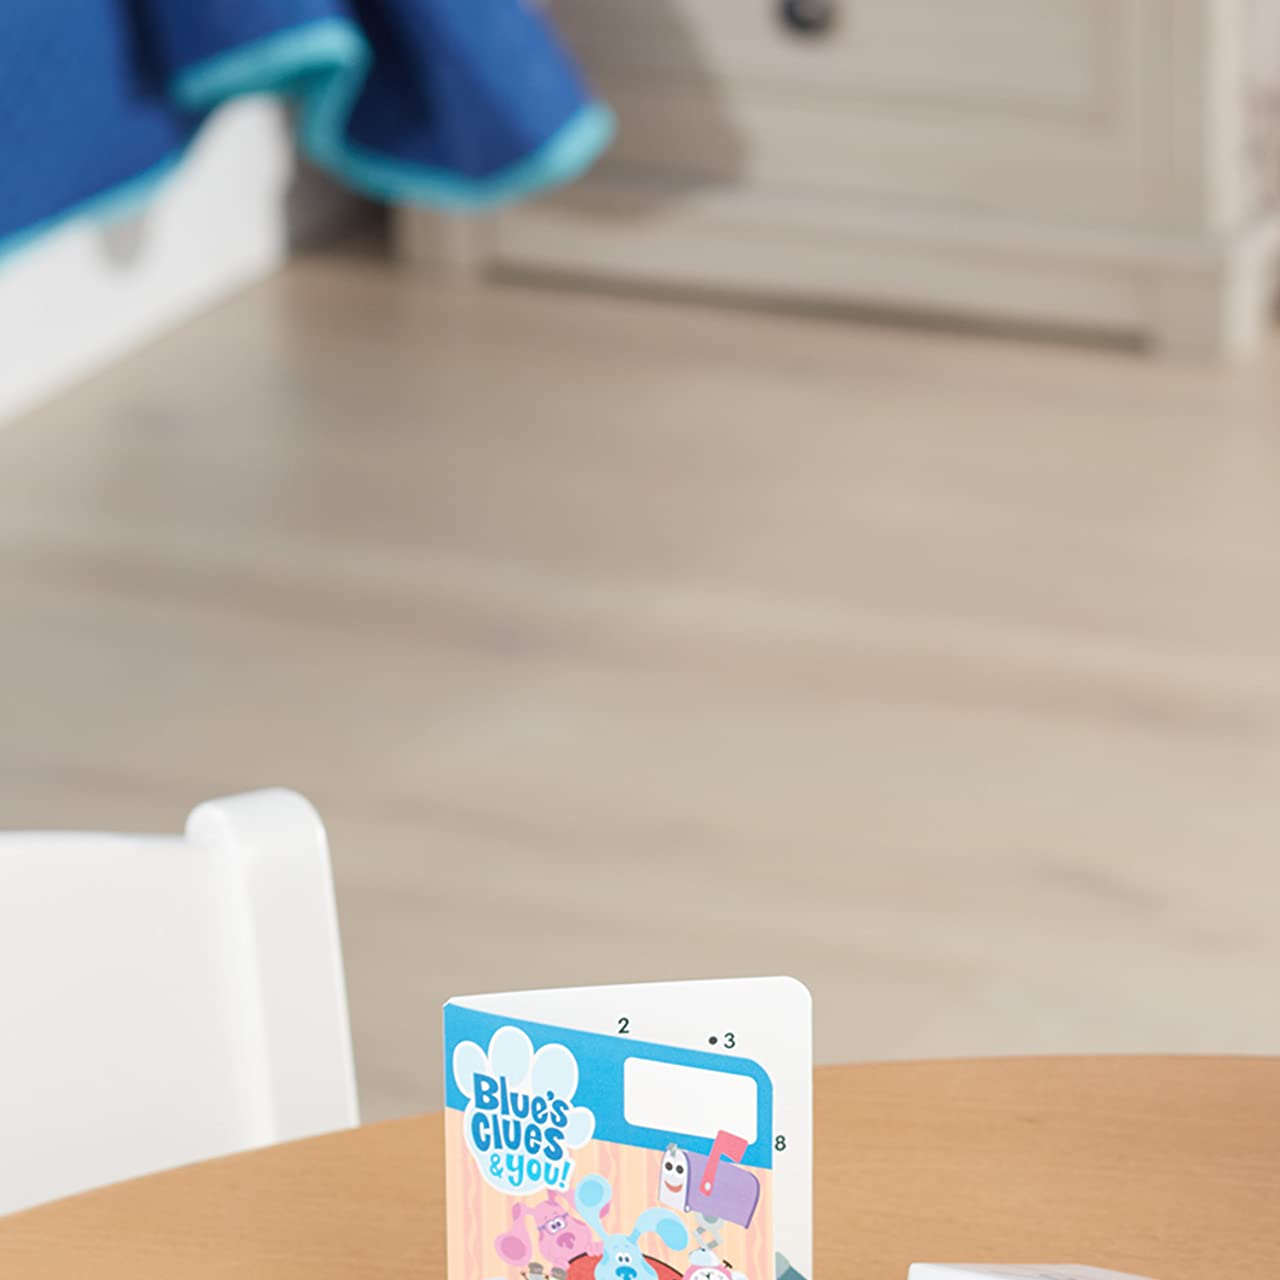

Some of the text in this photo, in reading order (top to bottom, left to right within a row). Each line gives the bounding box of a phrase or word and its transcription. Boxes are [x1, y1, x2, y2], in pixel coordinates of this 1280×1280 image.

[617, 1017, 630, 1034] 2
[723, 1032, 737, 1049] 3
[473, 1072, 570, 1128] Blue's
[471, 1112, 565, 1161] Clues
[774, 1135, 787, 1151] 8
